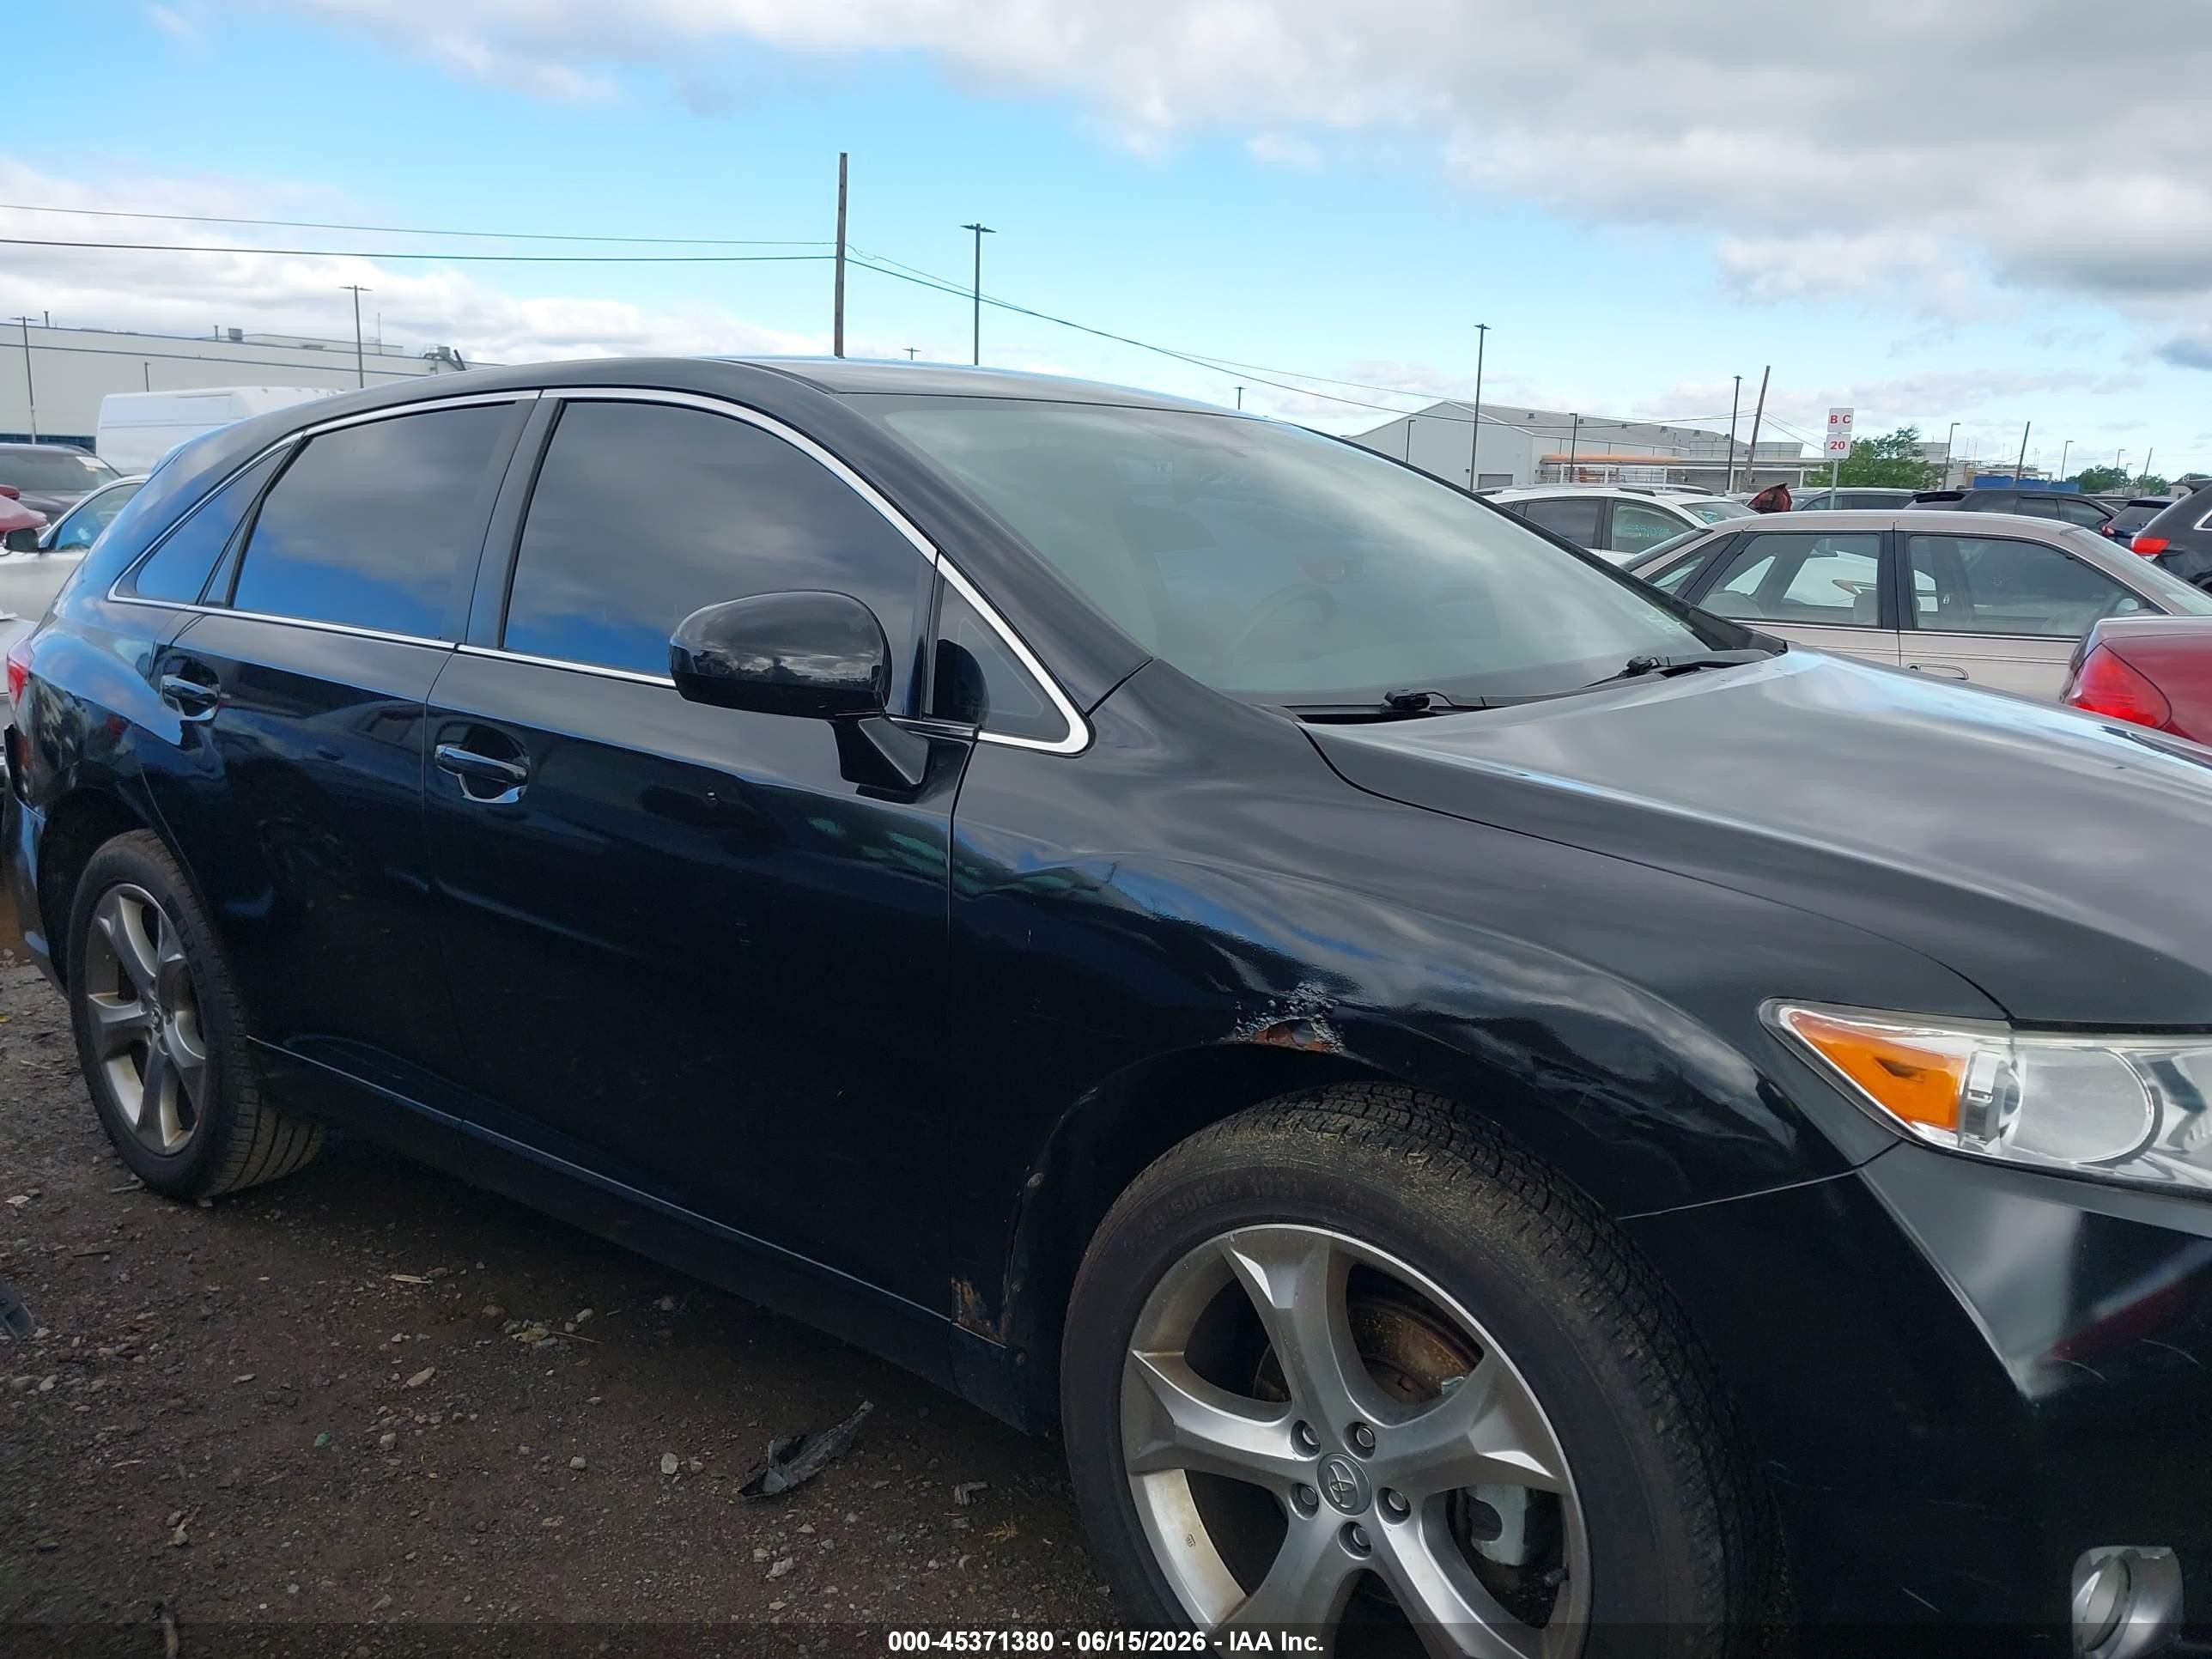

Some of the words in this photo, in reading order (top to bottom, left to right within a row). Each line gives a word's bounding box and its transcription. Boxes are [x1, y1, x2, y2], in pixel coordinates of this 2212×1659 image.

[1830, 415, 1838, 424] B
[1842, 414, 1851, 424] C
[1830, 441, 1845, 450] 20
